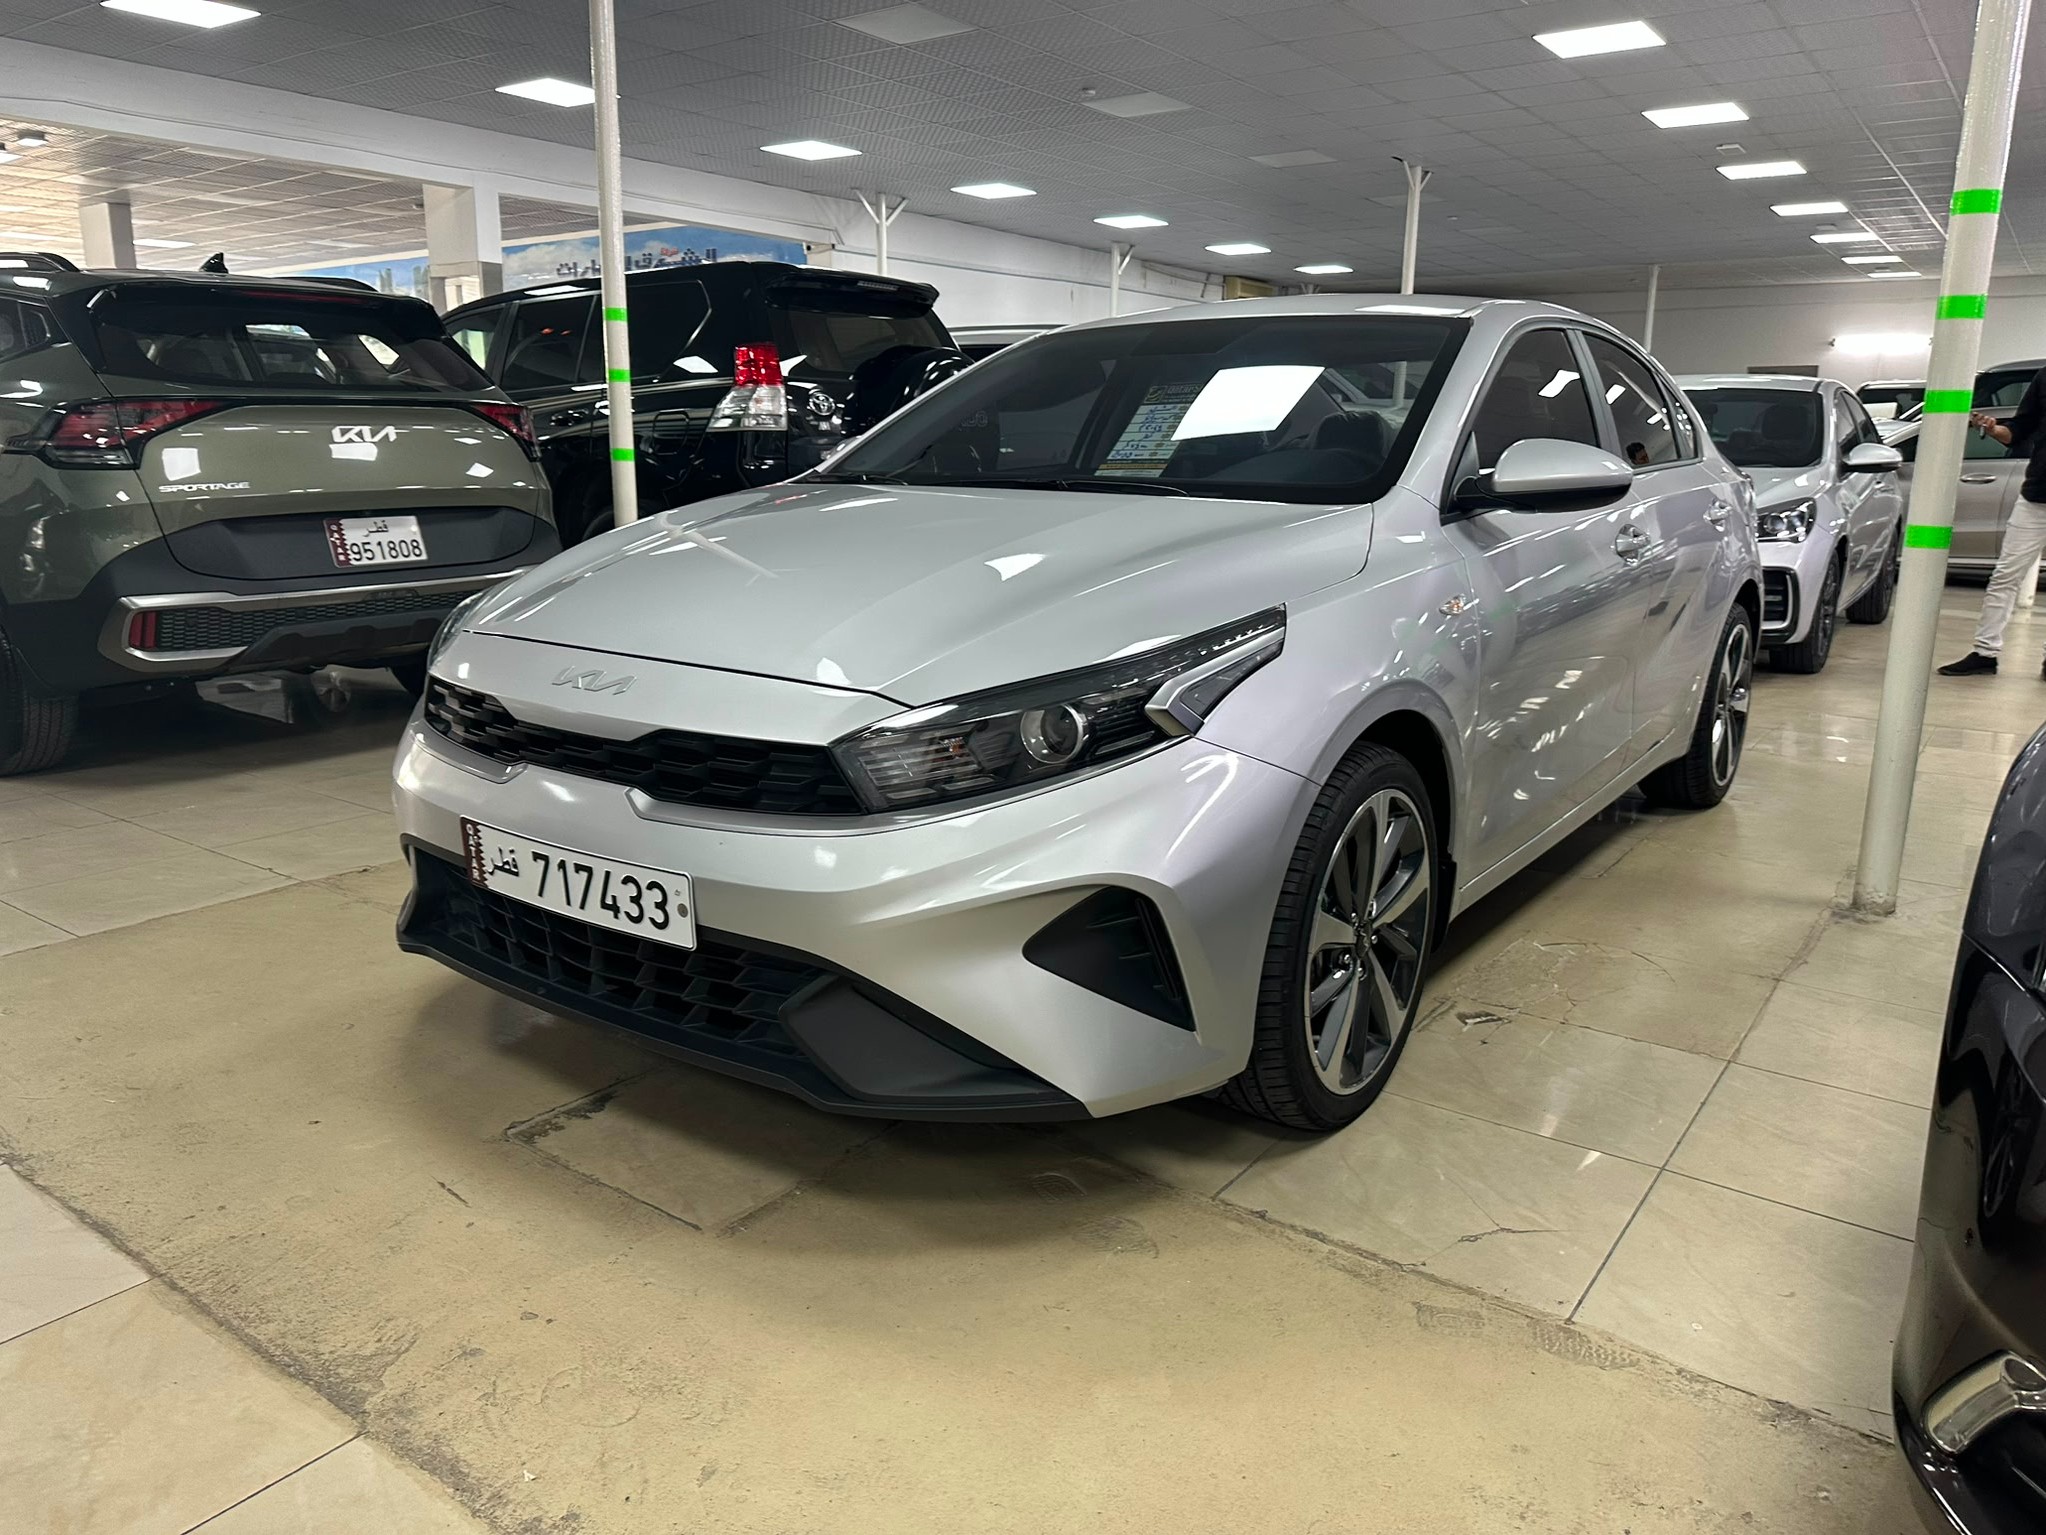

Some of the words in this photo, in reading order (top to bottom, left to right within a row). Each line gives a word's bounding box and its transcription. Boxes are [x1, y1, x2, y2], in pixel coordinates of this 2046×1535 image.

[331, 425, 397, 442] KIA
[159, 481, 250, 493] SPORTAGE
[363, 520, 389, 537] قطر
[349, 539, 423, 562] 951808
[551, 665, 637, 696] KIA
[466, 823, 481, 881] QATAR
[486, 845, 520, 877] قطر
[531, 850, 670, 930] 717433
